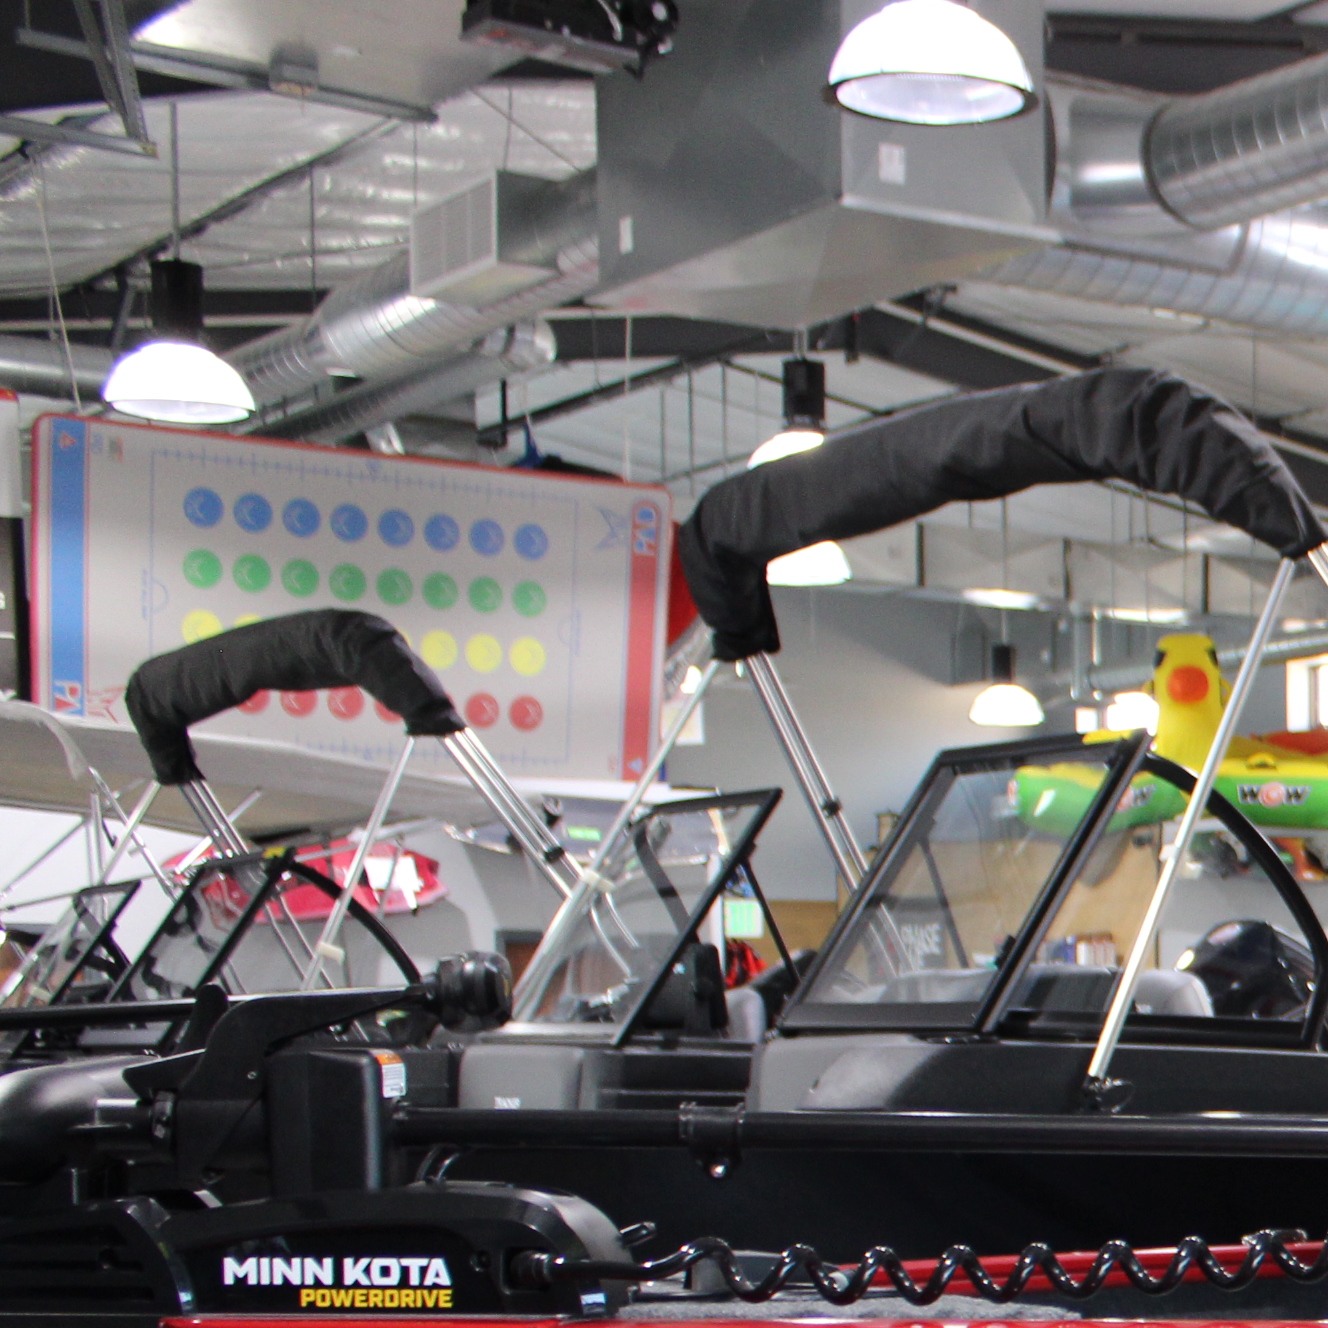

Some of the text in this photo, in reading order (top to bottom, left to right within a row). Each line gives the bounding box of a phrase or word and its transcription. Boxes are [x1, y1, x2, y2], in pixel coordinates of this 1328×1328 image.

[1237, 781, 1311, 808] WOW
[223, 1257, 453, 1287] MINN KOTA
[300, 1288, 453, 1309] POWERDRIVE
